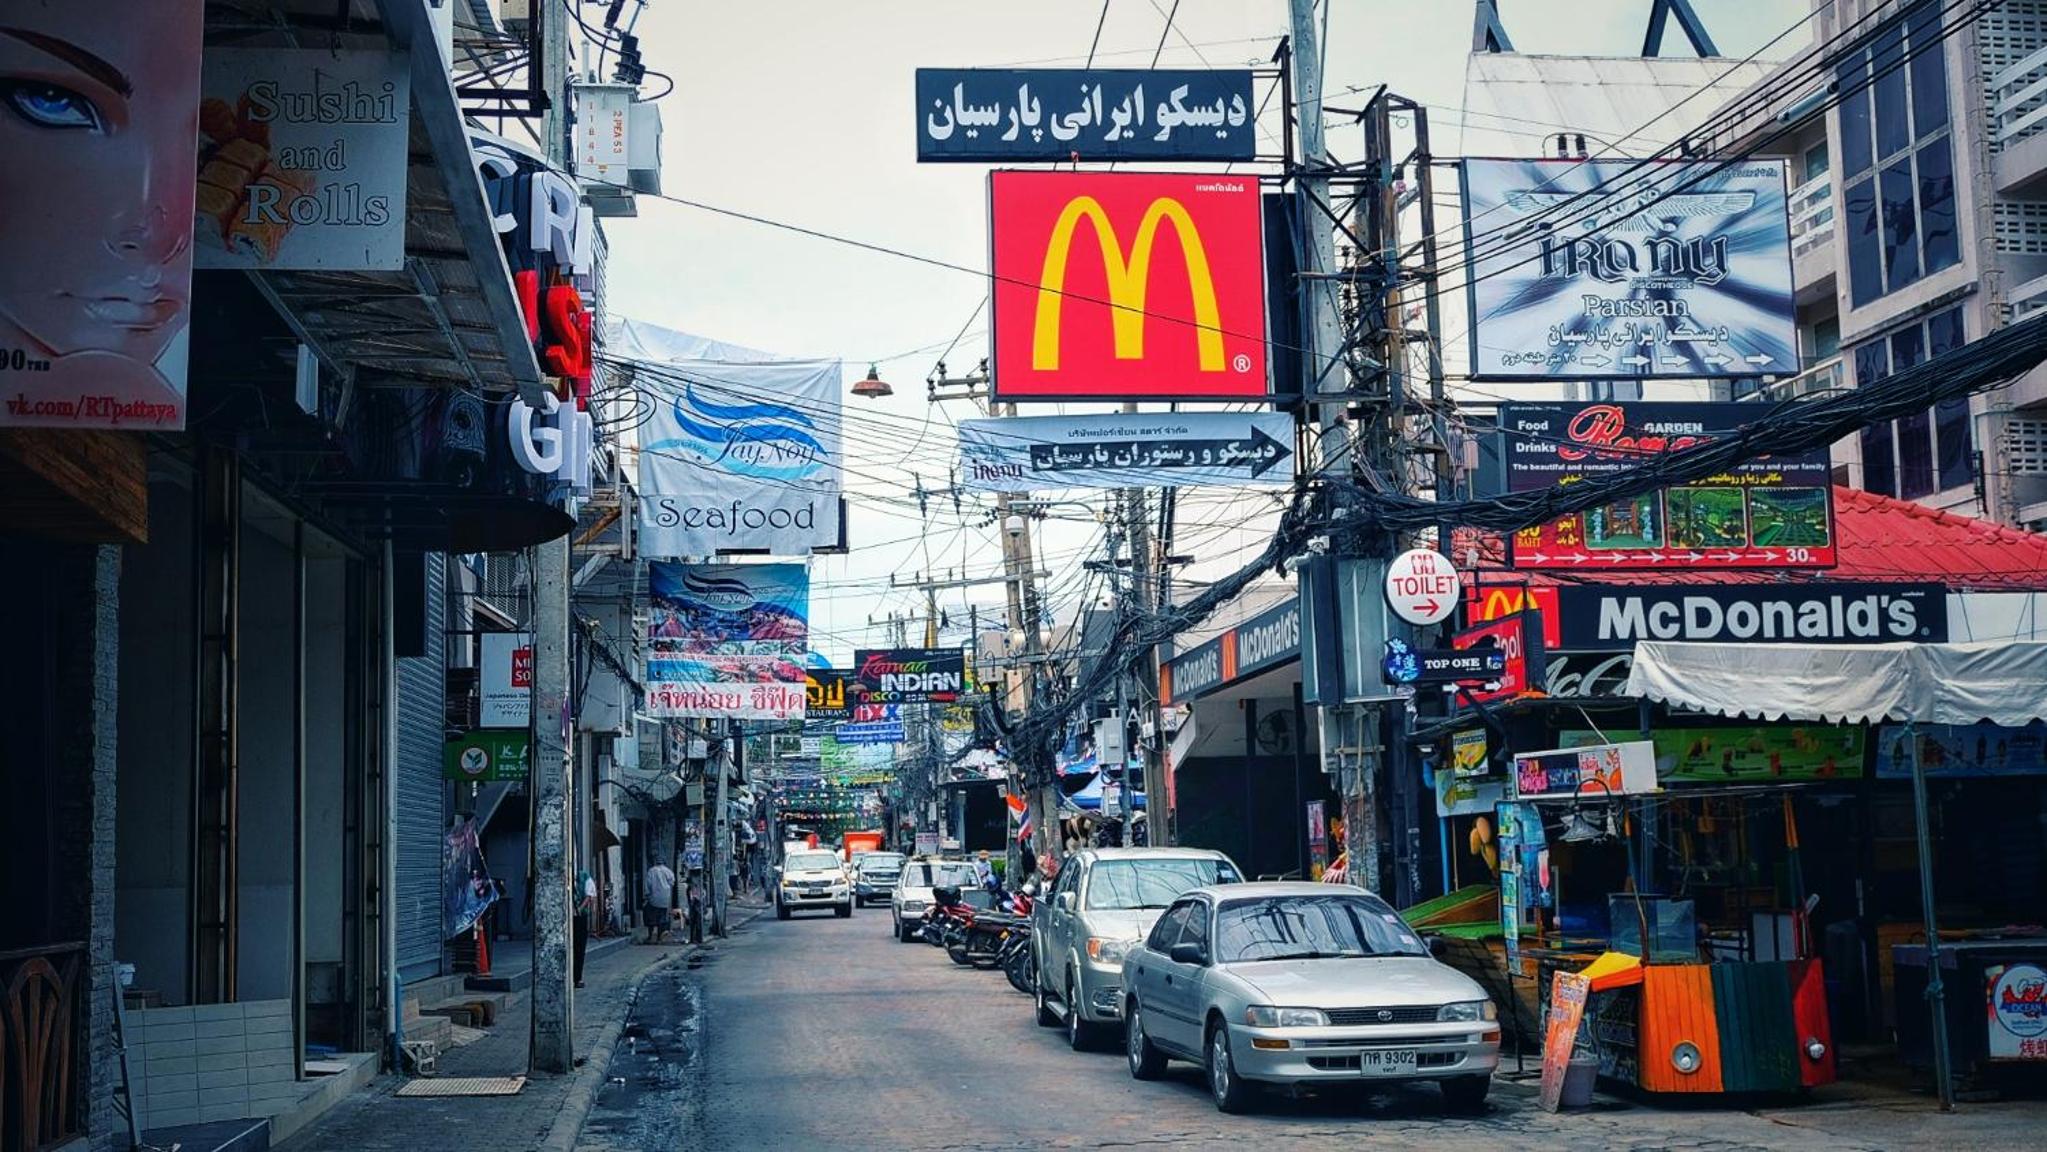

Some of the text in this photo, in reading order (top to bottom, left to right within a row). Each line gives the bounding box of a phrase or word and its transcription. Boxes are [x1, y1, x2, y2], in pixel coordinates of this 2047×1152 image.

[246, 79, 398, 124] Sushi
[926, 76, 1247, 143] دیسکو ایرانی پارسیان
[278, 138, 347, 171] and
[241, 182, 391, 226] Rolls
[1582, 295, 1691, 317] Parsian
[1517, 420, 1549, 430] Food
[1644, 422, 1703, 433] GARDEN
[1515, 442, 1557, 452] Drinks
[1583, 463, 1619, 471] romantic
[1801, 463, 1826, 471] family
[655, 499, 815, 535] Seafood
[1786, 548, 1809, 562] 30
[1392, 575, 1456, 597] TOILET
[1597, 594, 1918, 640] McDonald's
[1239, 608, 1300, 669] McDonald's
[1172, 648, 1218, 698] McDonald's
[1424, 659, 1449, 670] TOP
[1451, 657, 1480, 668] ONE
[881, 671, 960, 692] INDIAN
[860, 691, 900, 702] DISCO
[1385, 1051, 1414, 1064] 9302
